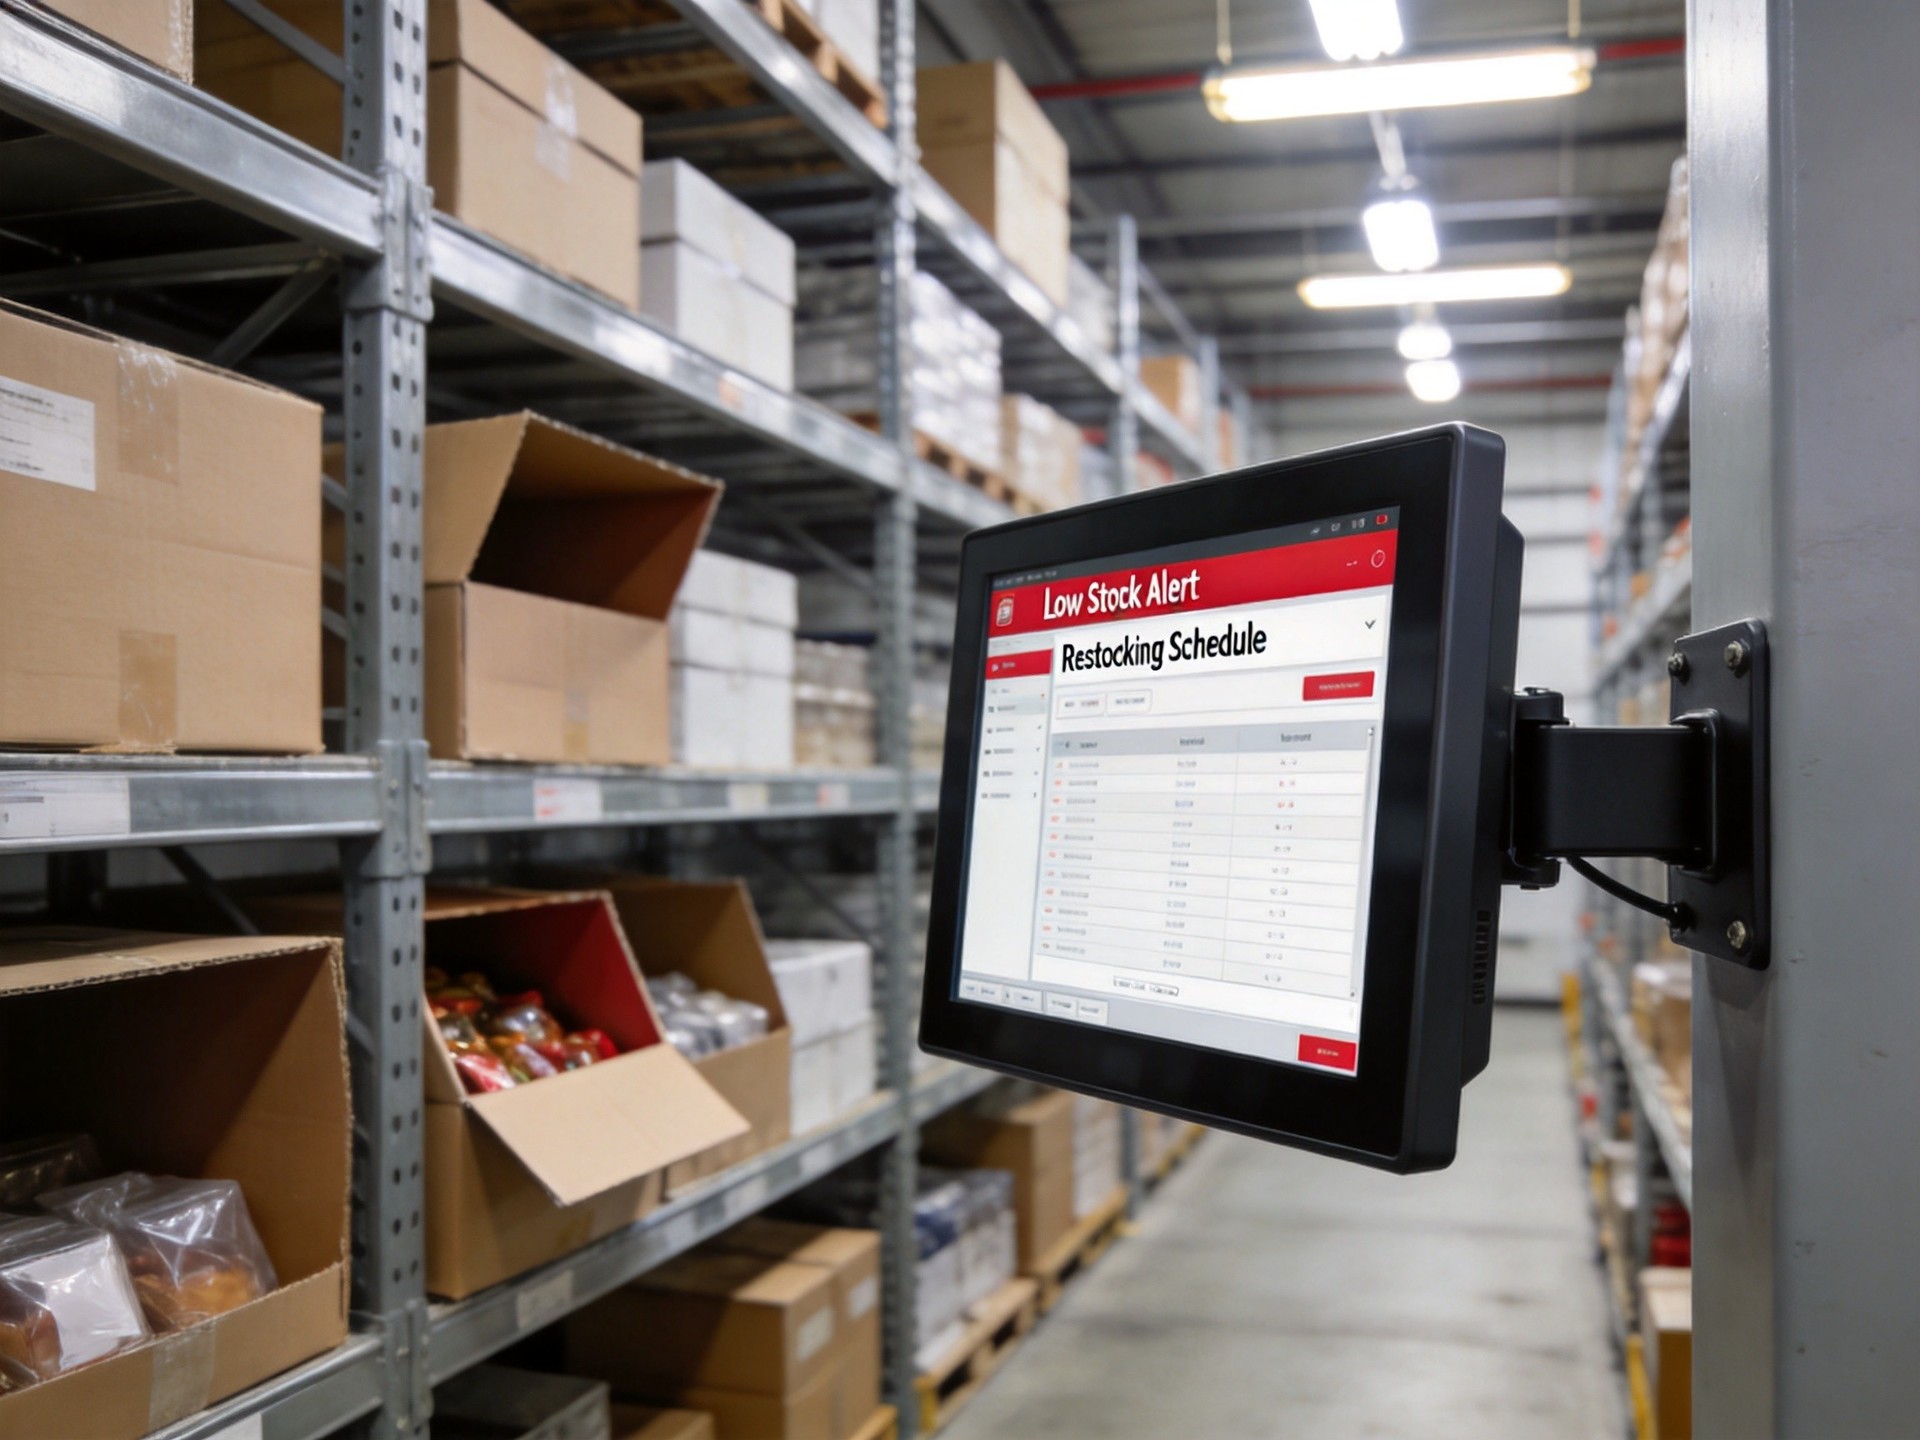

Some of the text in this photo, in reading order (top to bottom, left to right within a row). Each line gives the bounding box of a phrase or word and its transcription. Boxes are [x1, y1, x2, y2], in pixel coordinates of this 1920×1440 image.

[1043, 587, 1083, 620] Low
[1087, 574, 1142, 615] Stock
[1145, 568, 1201, 606] Alert
[1061, 620, 1267, 672] Restocking Schedule
